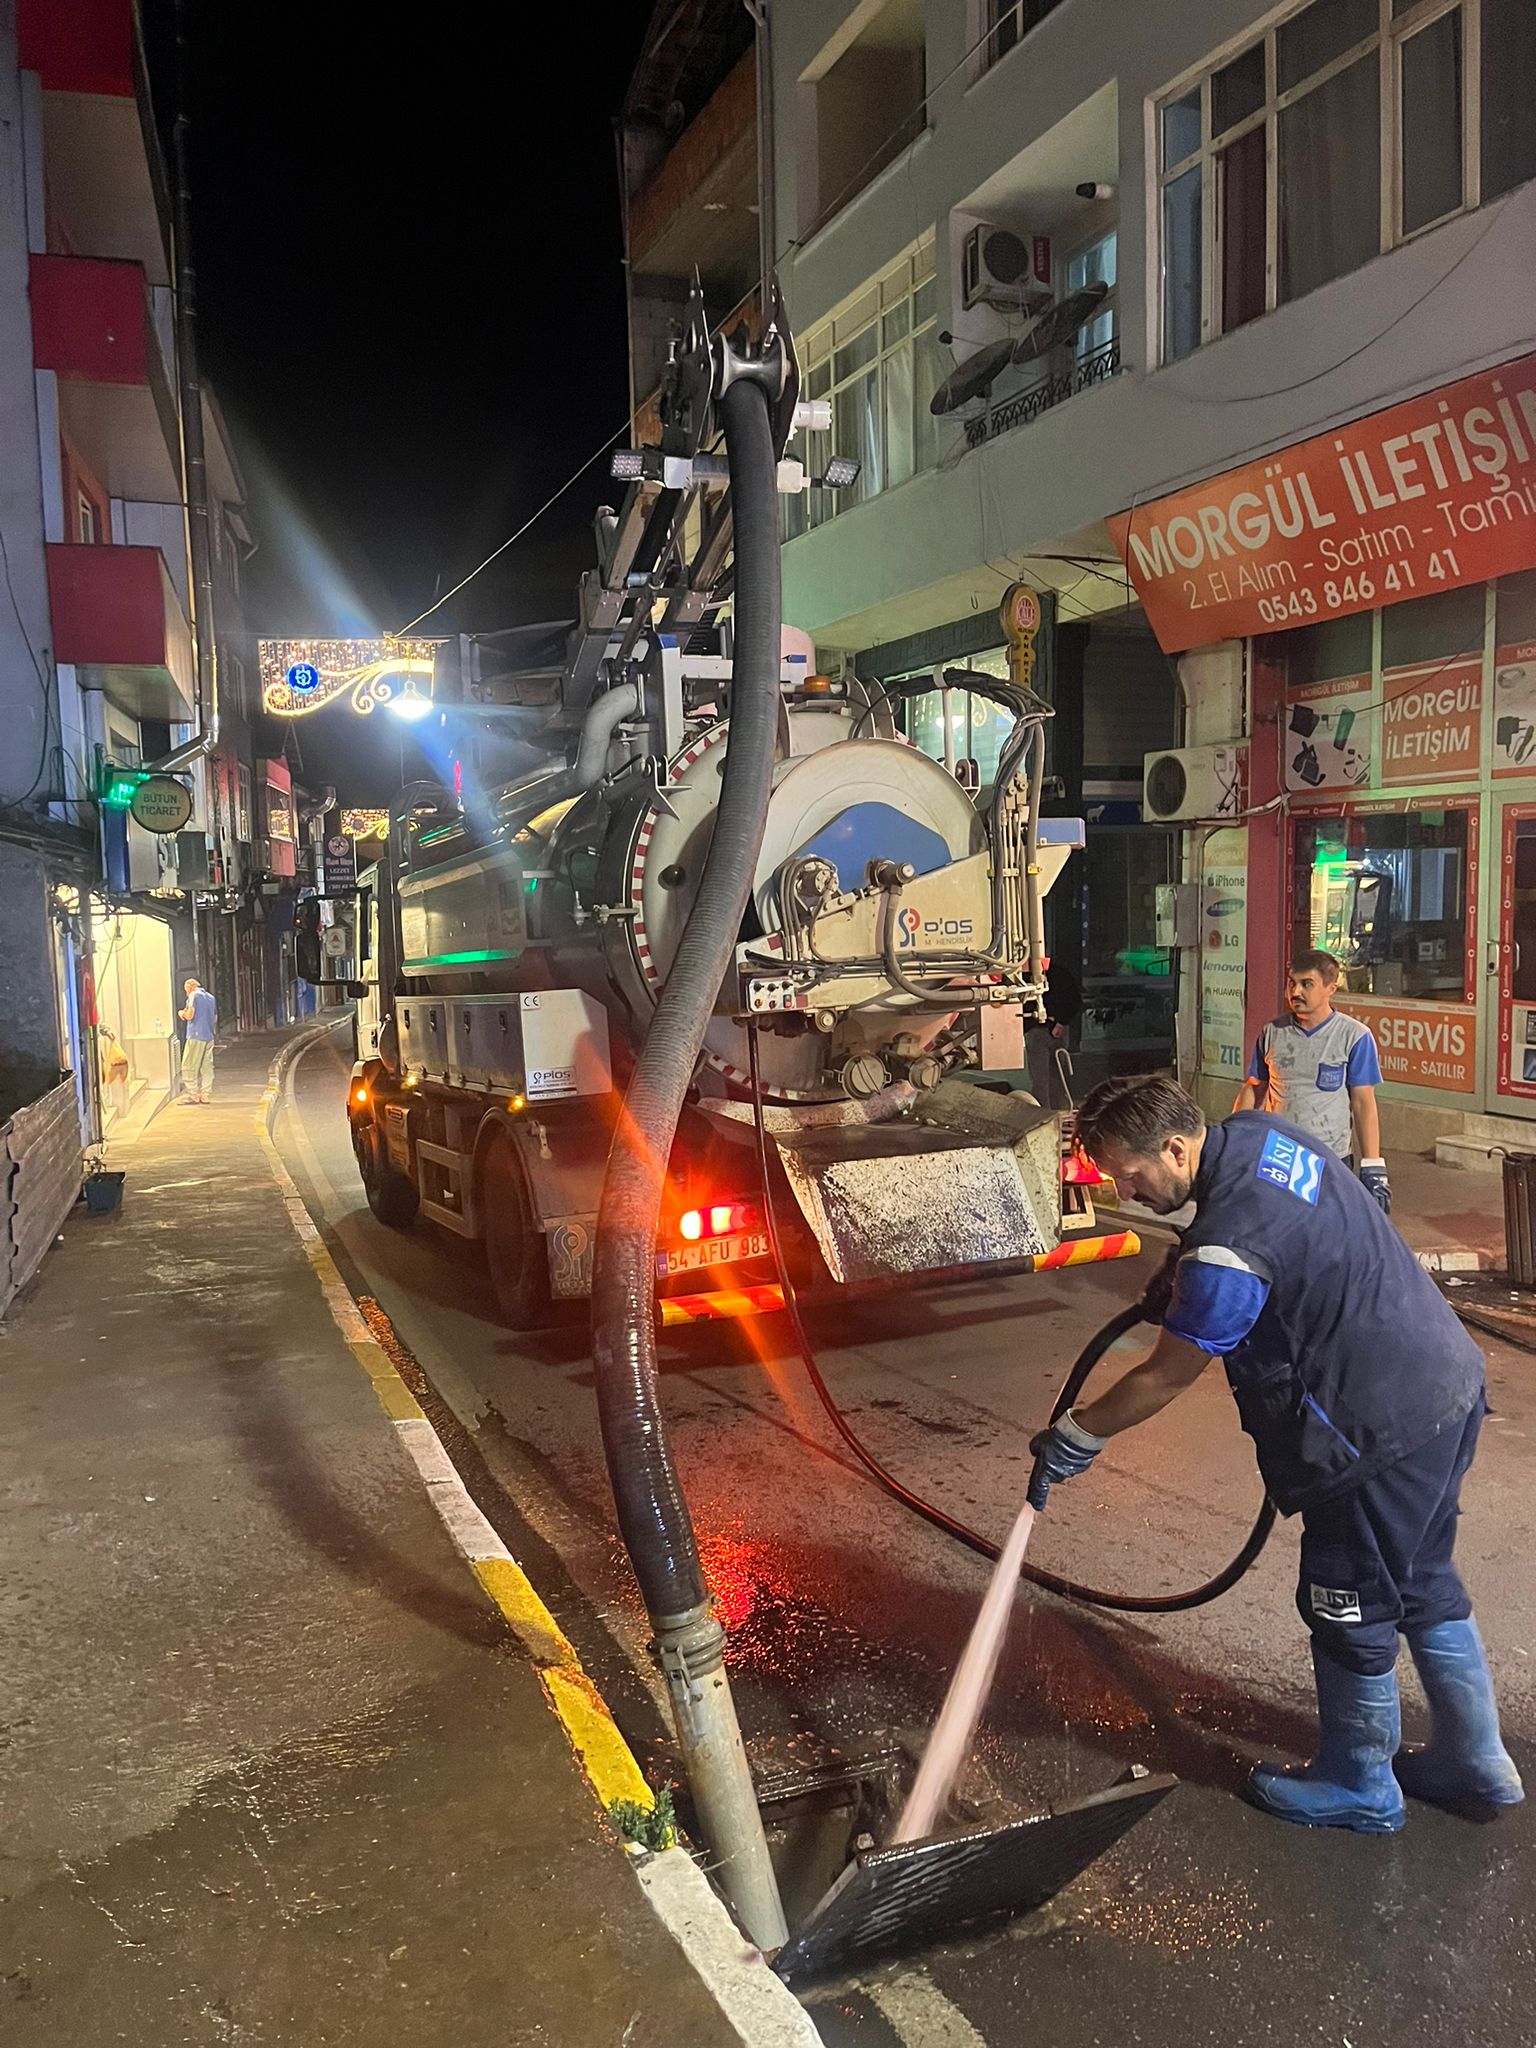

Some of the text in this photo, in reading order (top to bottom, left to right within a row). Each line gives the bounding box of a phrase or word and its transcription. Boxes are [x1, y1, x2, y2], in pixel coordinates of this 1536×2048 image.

[1128, 463, 1336, 582] MORGÜL
[1184, 580, 1208, 610] 2.
[1208, 570, 1232, 603] El
[1239, 560, 1297, 598] Alım
[1319, 523, 1415, 572] Satım
[1436, 477, 1536, 538] Tami
[1258, 547, 1461, 624] 0543 846 41 41
[1384, 680, 1481, 724] MORGÜL
[1386, 721, 1472, 762] İLETİŞİM
[1215, 874, 1245, 888] iPhone
[1224, 934, 1239, 948] LG
[1203, 959, 1244, 974] lenovo
[1220, 1044, 1241, 1067] ZTE
[1378, 1015, 1466, 1057] SERVİS
[1379, 1055, 1409, 1073] LINIR
[1420, 1060, 1466, 1080] SATILIR
[668, 1249, 689, 1271] 54
[699, 1241, 730, 1265] AFU
[741, 1234, 770, 1257] 983
